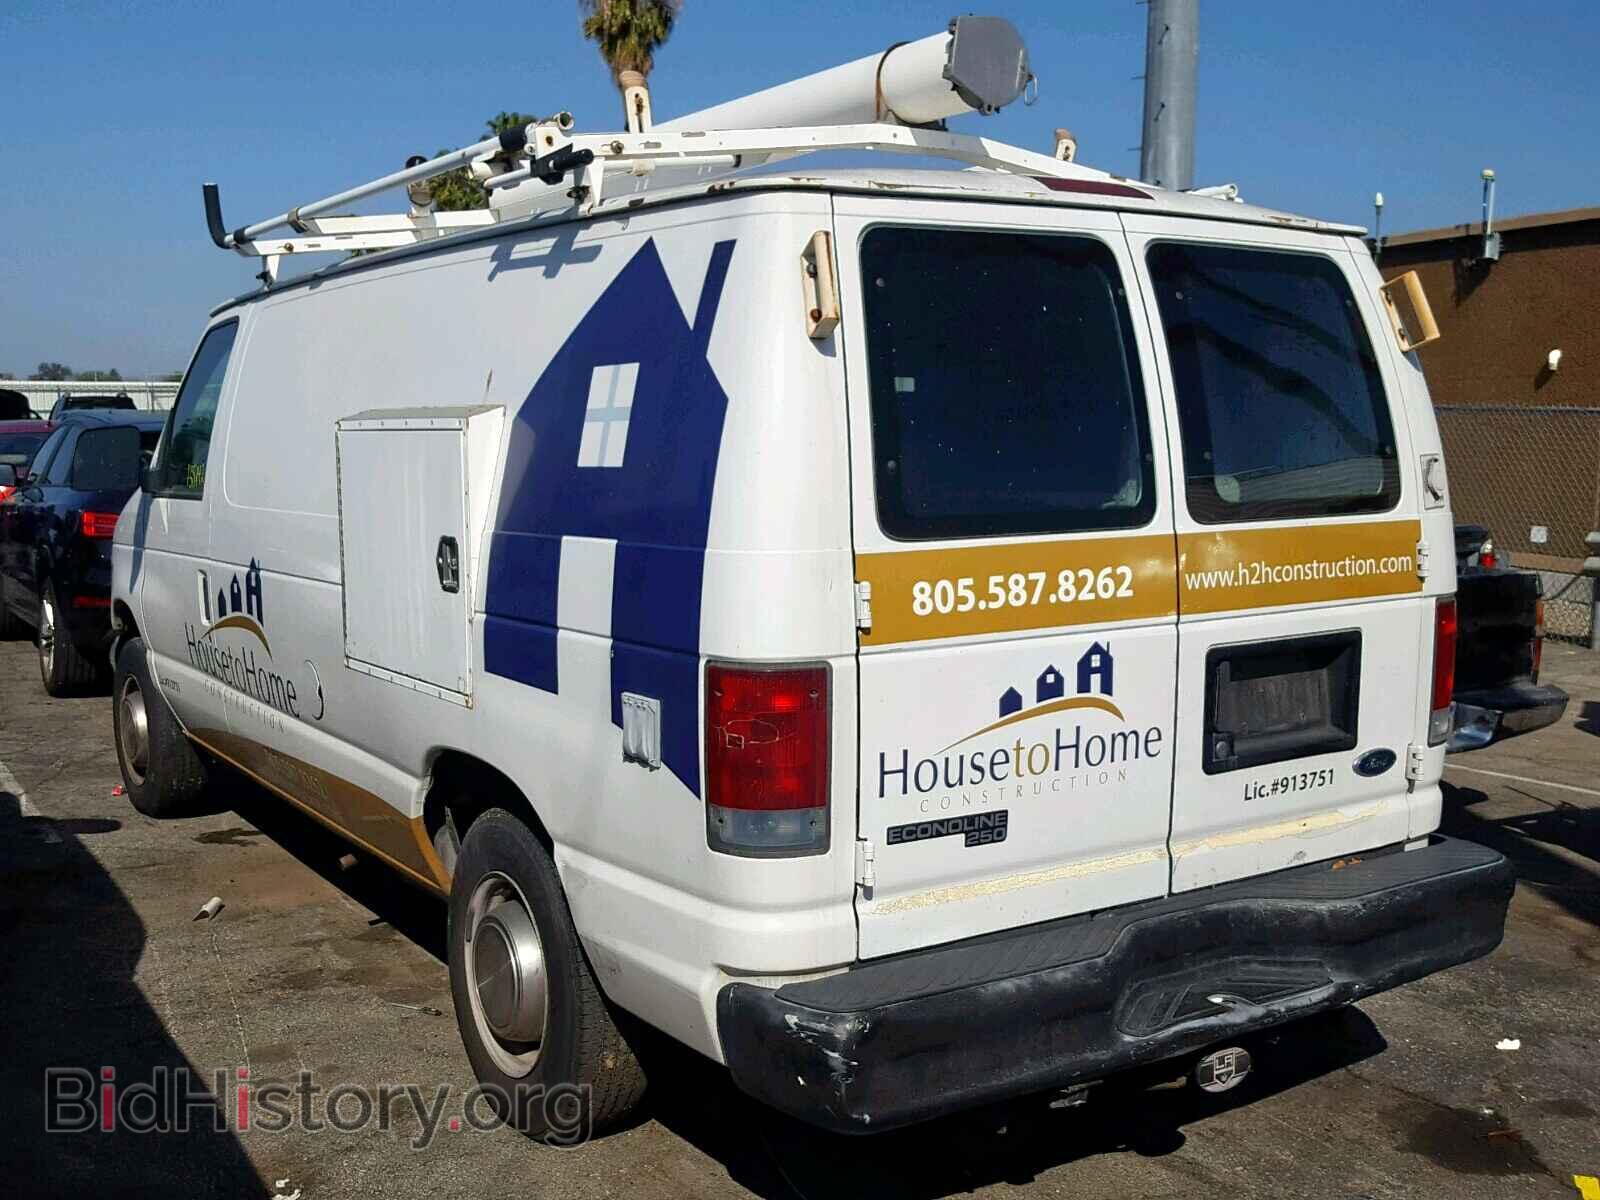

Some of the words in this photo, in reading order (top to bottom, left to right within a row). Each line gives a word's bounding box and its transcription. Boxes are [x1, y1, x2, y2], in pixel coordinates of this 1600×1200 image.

[1184, 554, 1413, 591] www.h2hconstruction.com
[911, 565, 1135, 617] 805.587.8262
[919, 768, 1128, 813] CONSTRUCTION
[1243, 767, 1335, 801] Lic.#913751
[888, 811, 1007, 843] ECONOLINE
[966, 829, 1006, 847] 250
